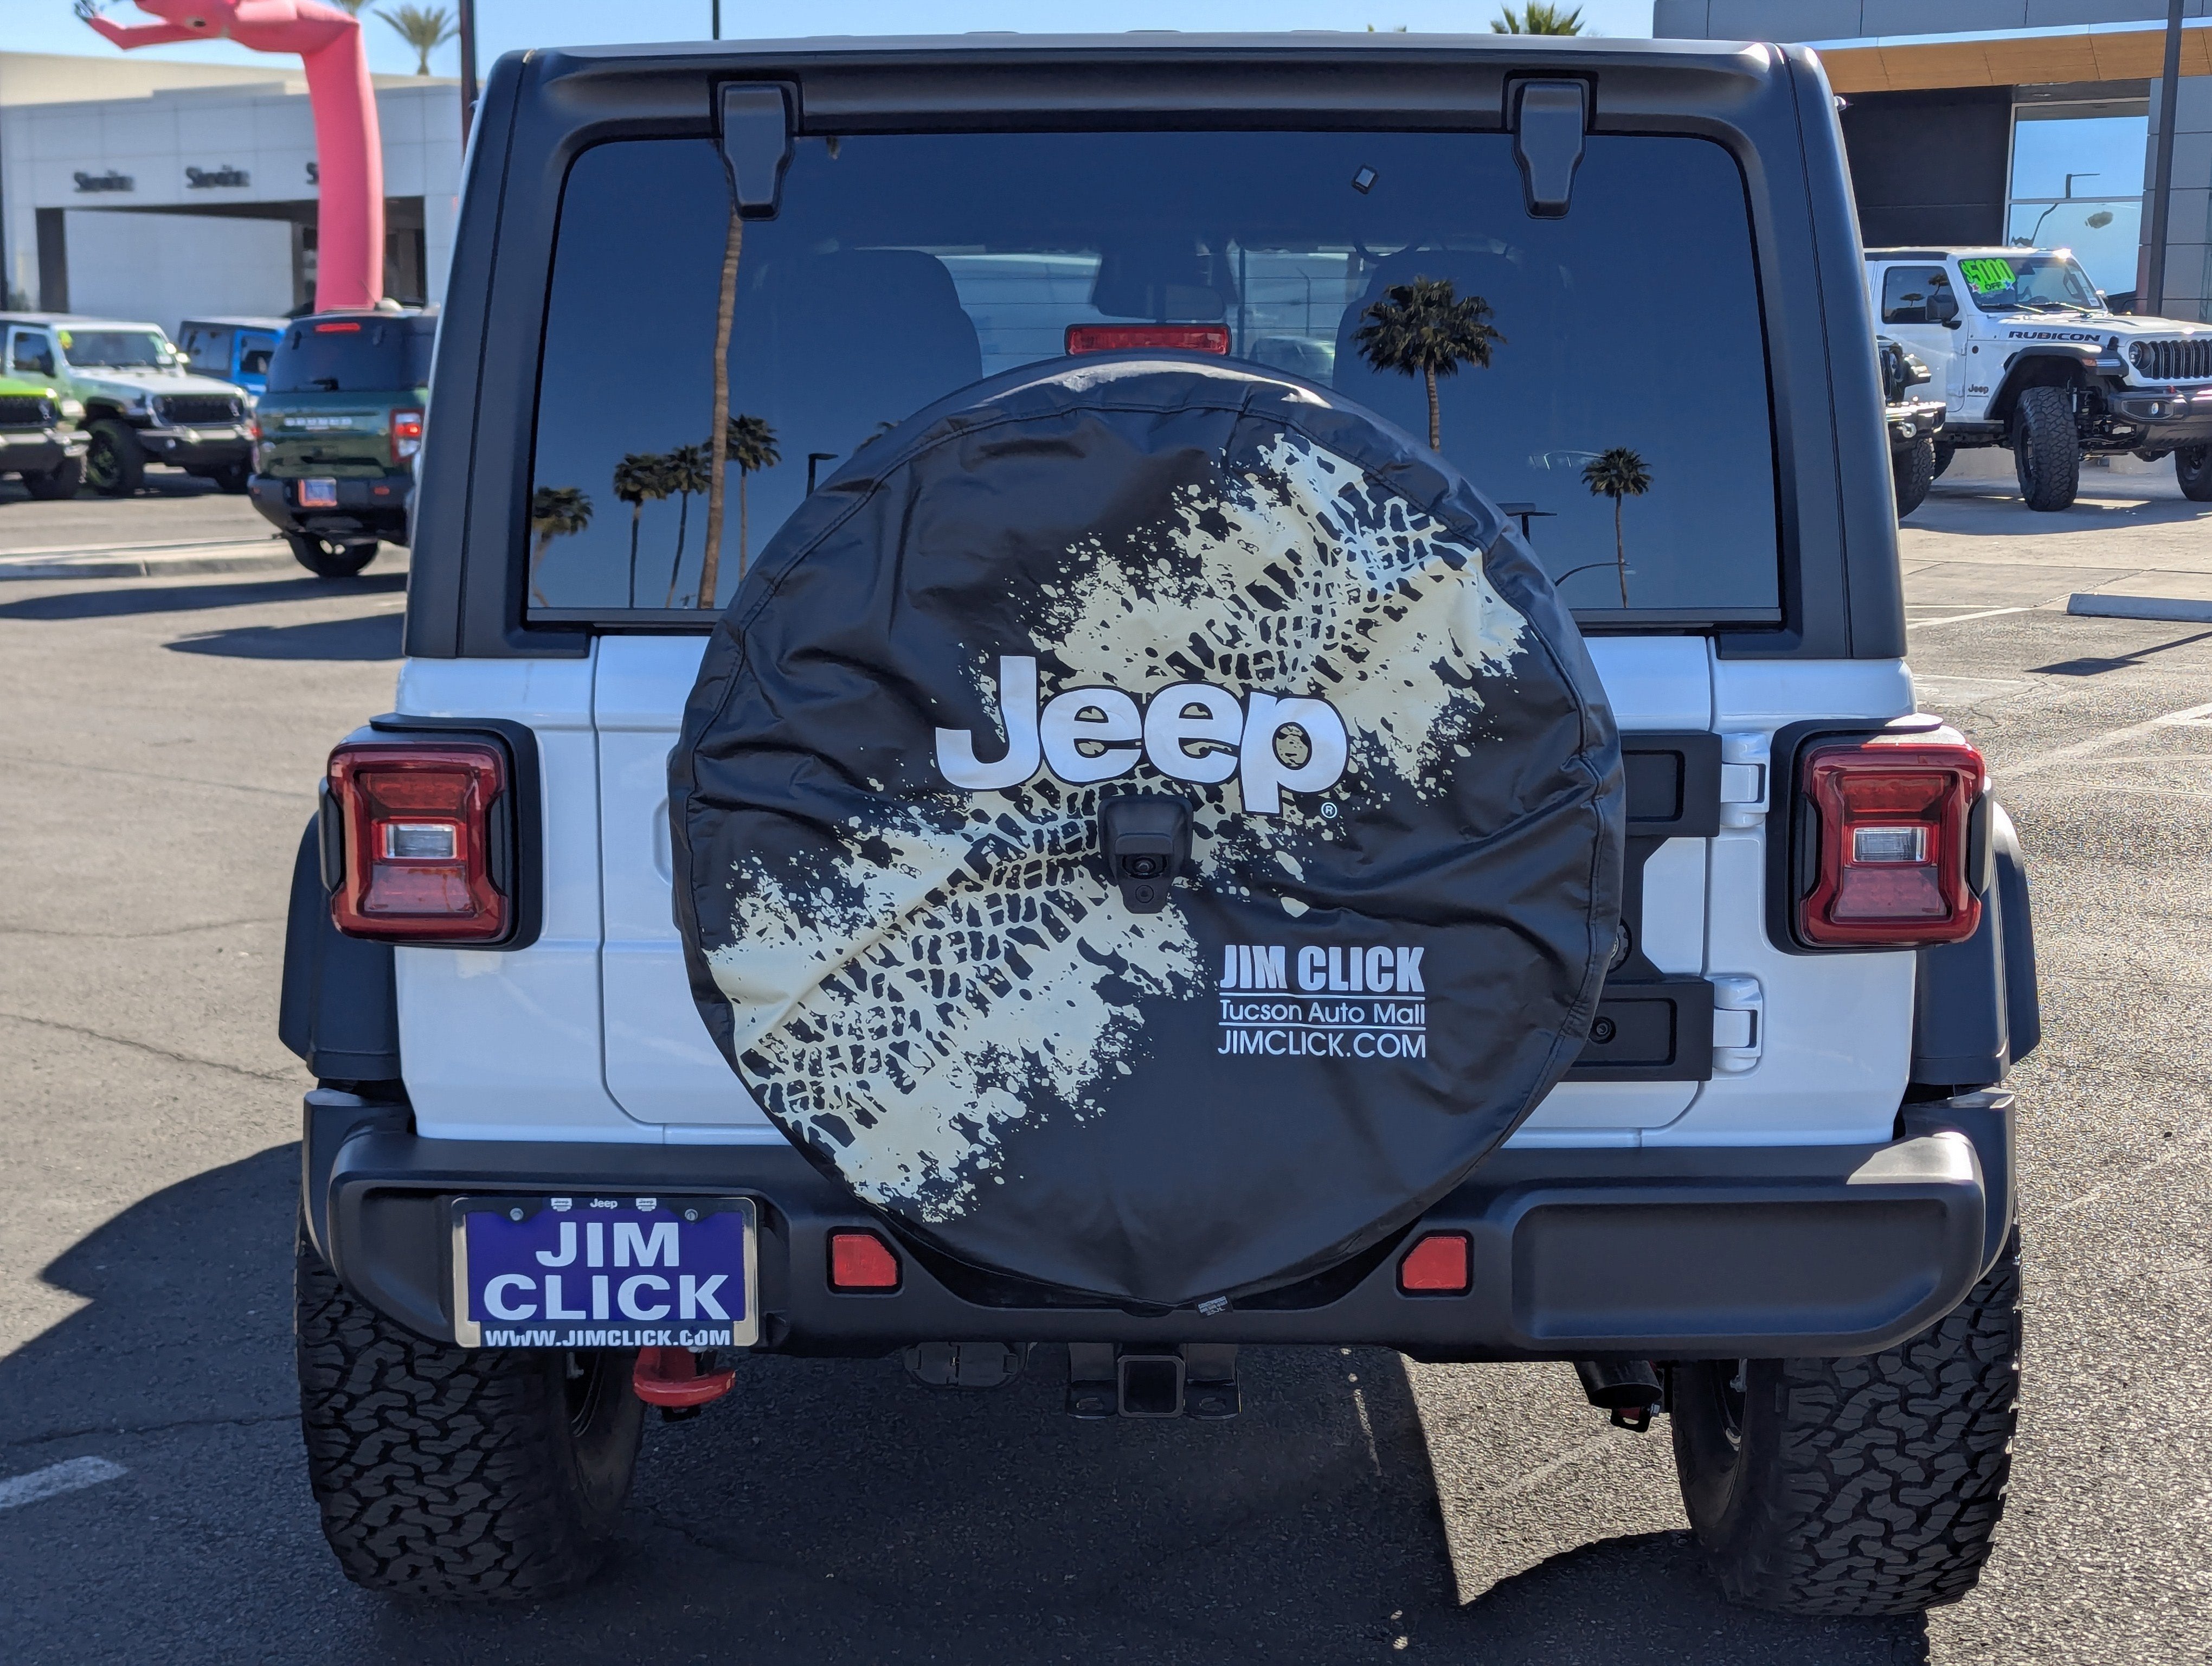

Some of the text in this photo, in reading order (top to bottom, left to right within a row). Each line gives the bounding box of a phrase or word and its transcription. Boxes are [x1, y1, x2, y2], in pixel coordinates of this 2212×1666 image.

[1961, 259, 2016, 284] $5000
[1984, 281, 2002, 291] OFF
[2008, 331, 2101, 342] RUBICON
[1968, 384, 1989, 394] Jeep
[935, 655, 1348, 815] Jeep
[1219, 945, 1425, 992] JIM CLICK
[1219, 999, 1425, 1024] Tucson Auto Mall
[1218, 1030, 1426, 1058] JIMCLICK.COM
[590, 1198, 618, 1209] Jeep
[536, 1221, 680, 1268] JIM
[483, 1273, 731, 1321] CLICK
[485, 1330, 730, 1347] WWW.JIMCLICK.COM
